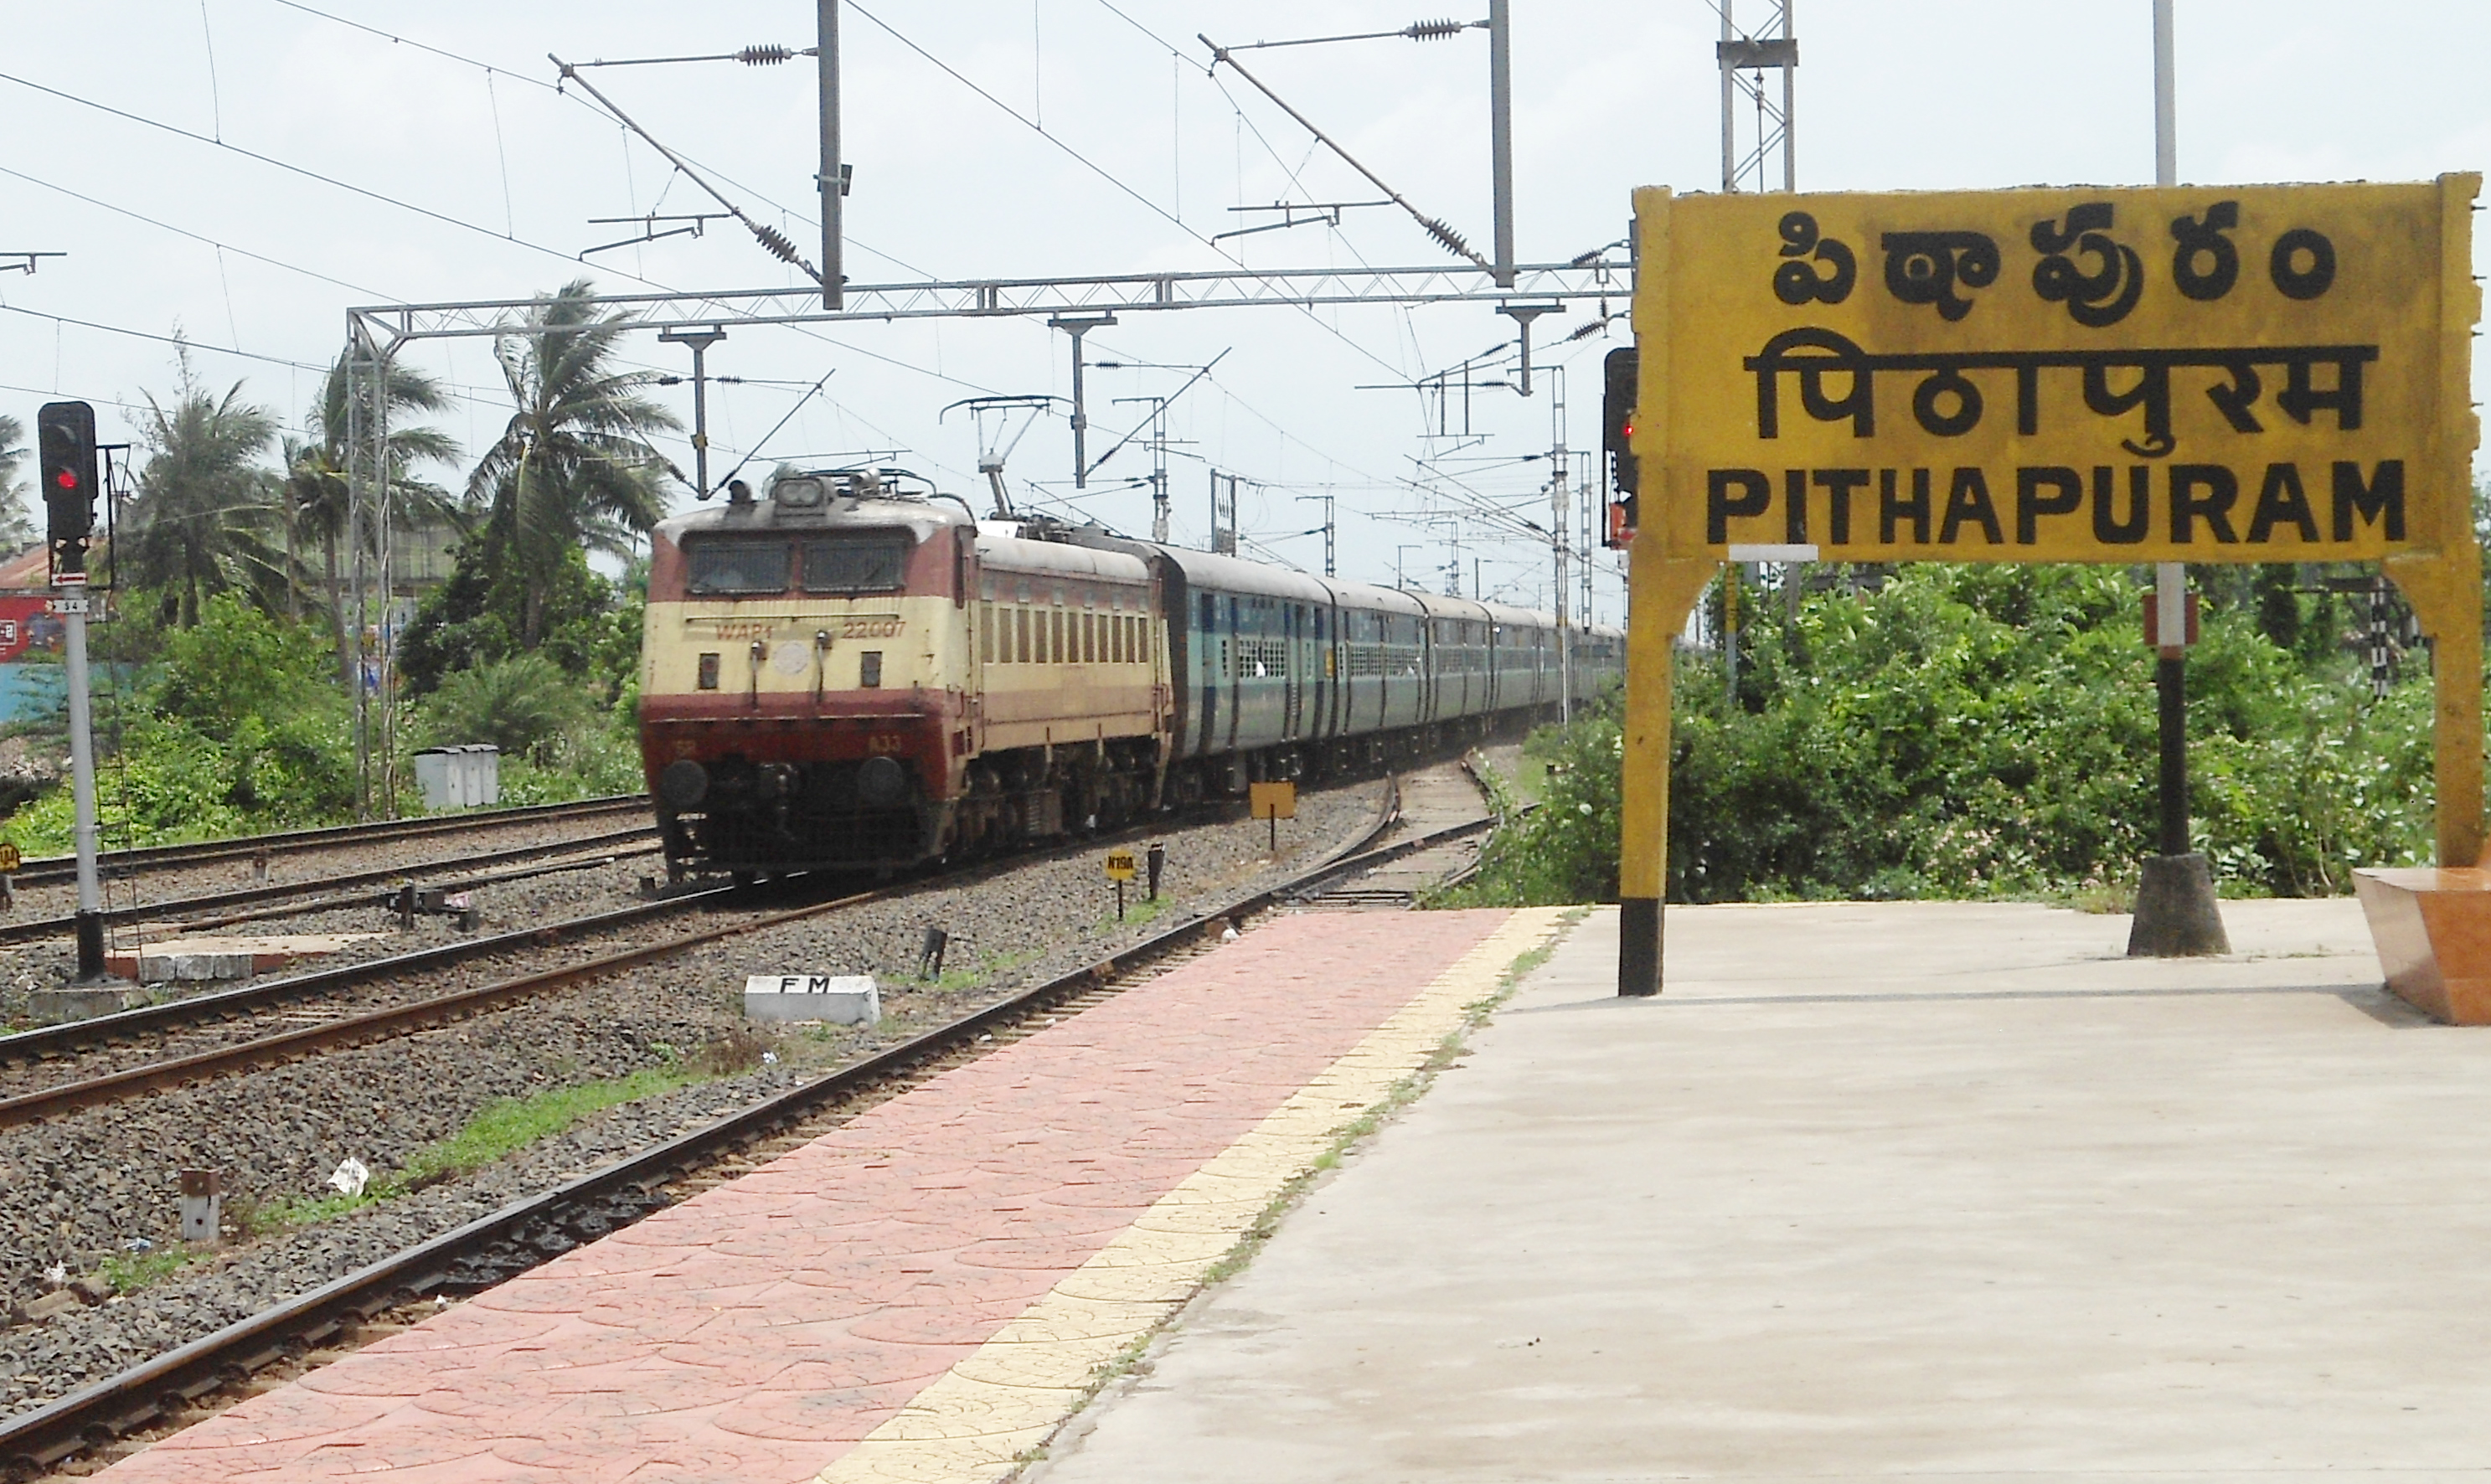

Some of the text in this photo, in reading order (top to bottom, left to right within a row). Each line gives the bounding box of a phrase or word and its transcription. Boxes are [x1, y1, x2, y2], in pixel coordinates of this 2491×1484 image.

[1743, 327, 2380, 459] पिठापुरम
[1706, 459, 2406, 545] PITHAPURAM
[840, 621, 907, 639] 22007
